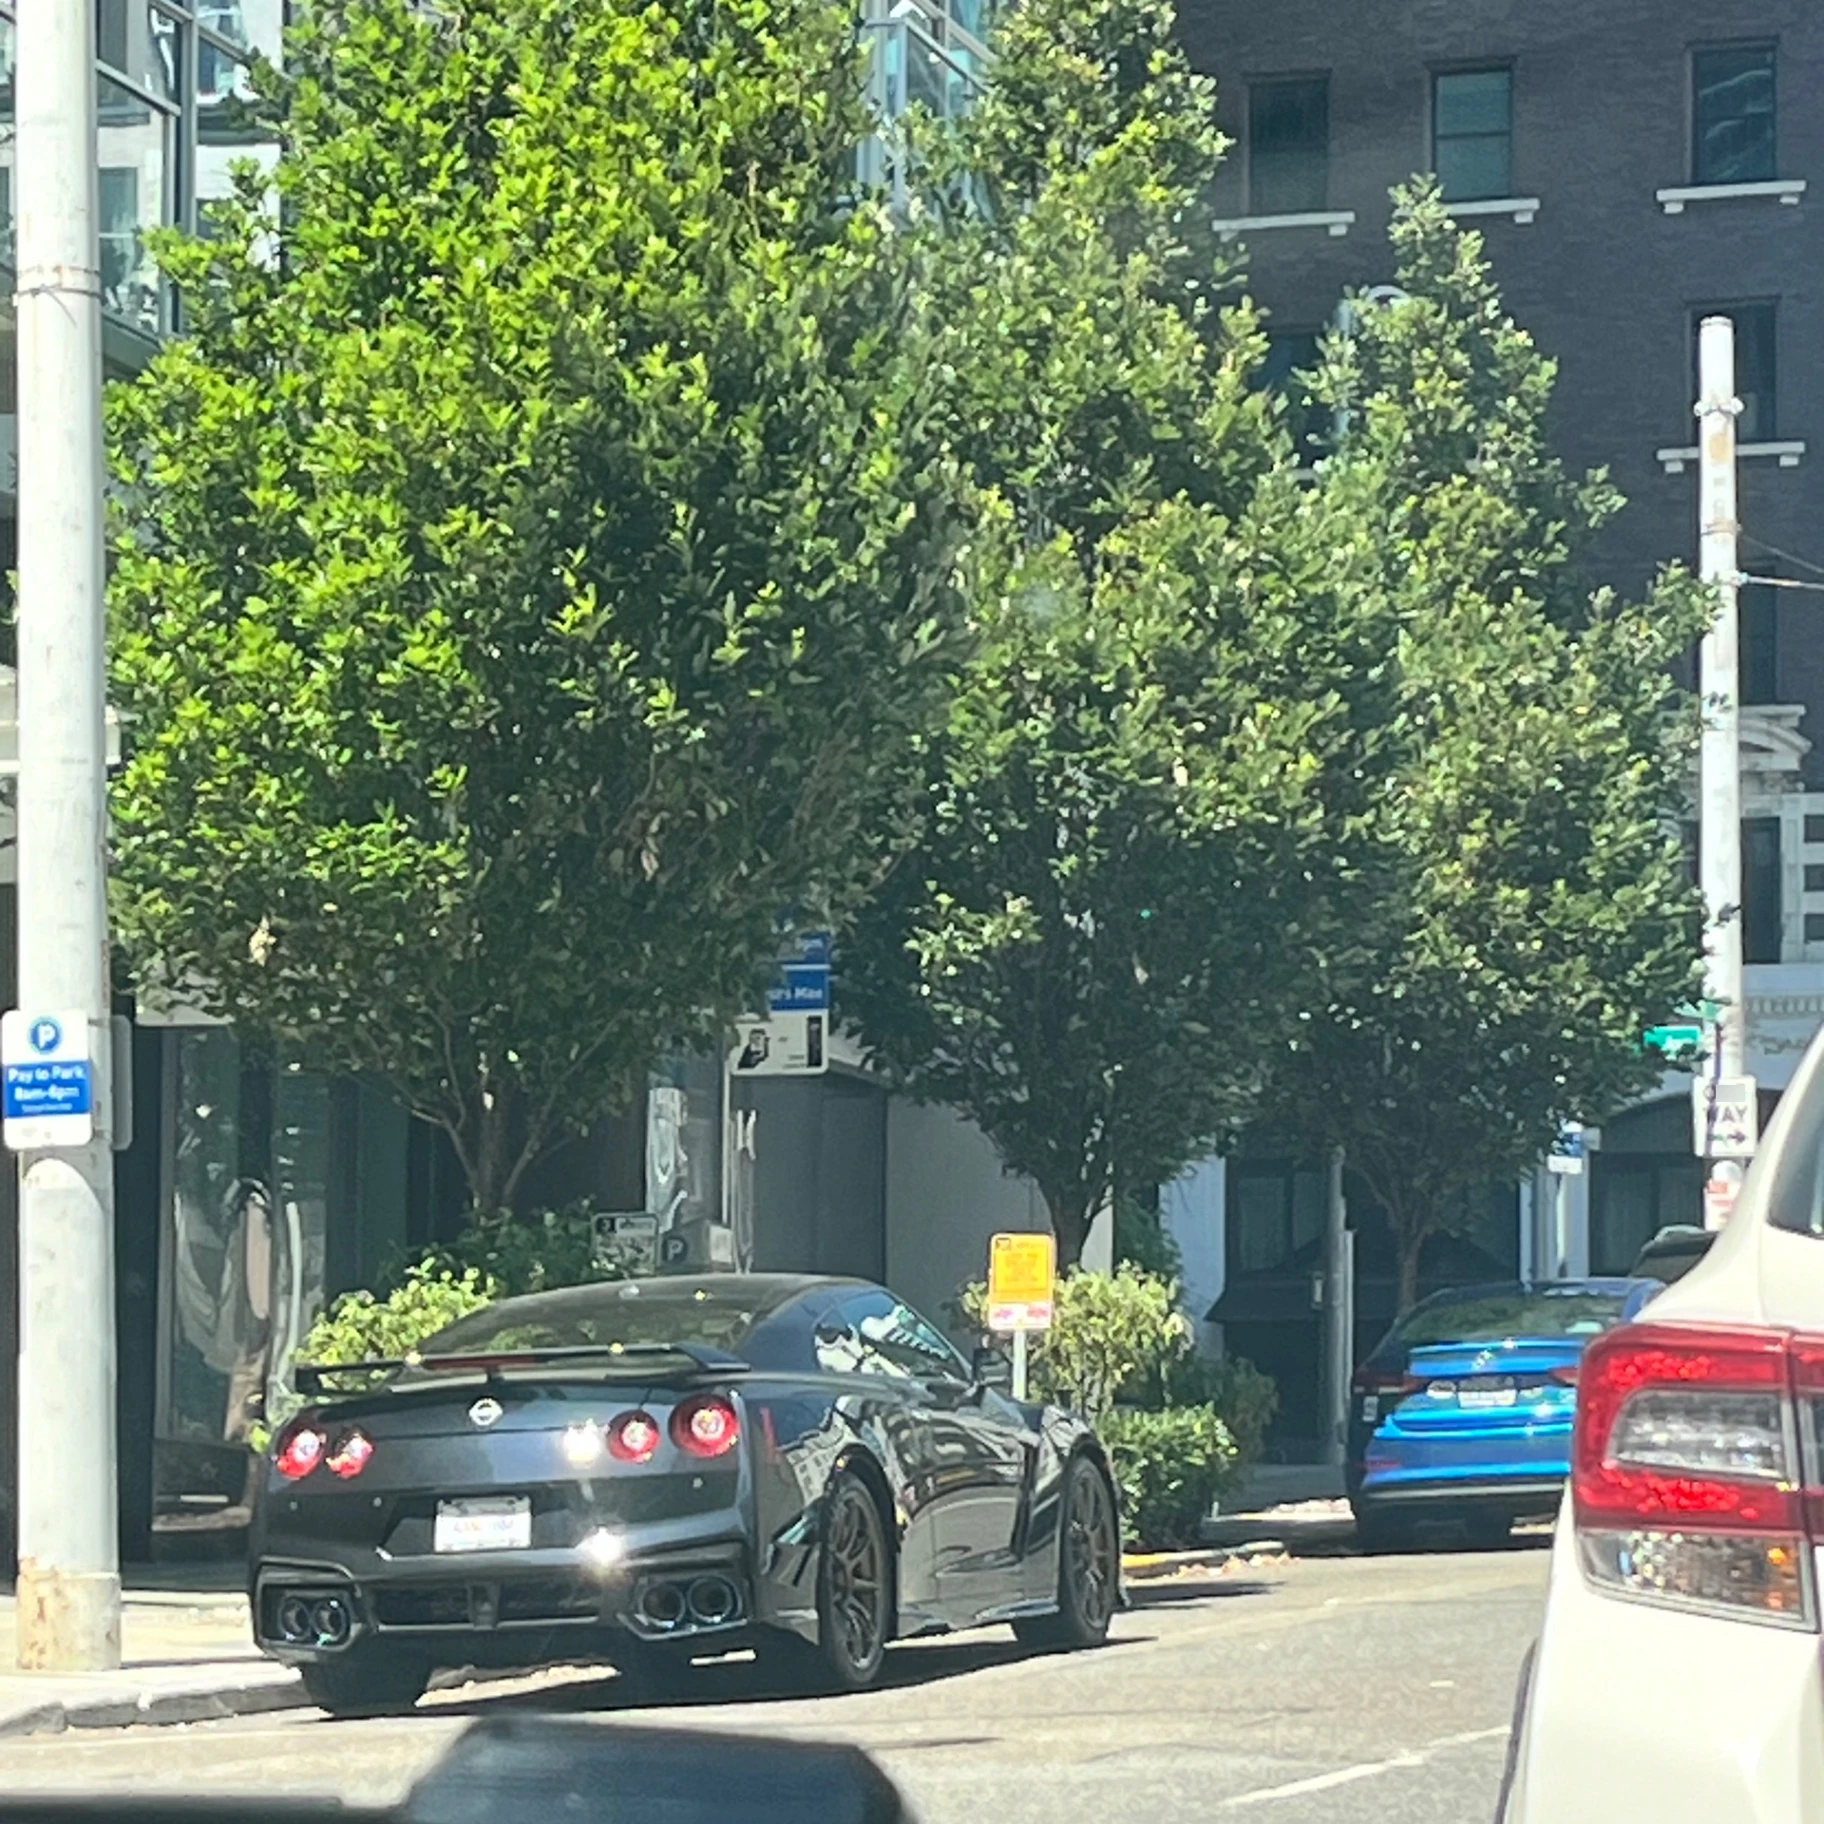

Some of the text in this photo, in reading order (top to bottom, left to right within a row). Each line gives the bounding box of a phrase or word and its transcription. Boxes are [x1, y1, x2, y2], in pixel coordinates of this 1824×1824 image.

[38, 1024, 56, 1049] P
[8, 1065, 86, 1084] Pay to Park
[668, 1239, 684, 1261] P
